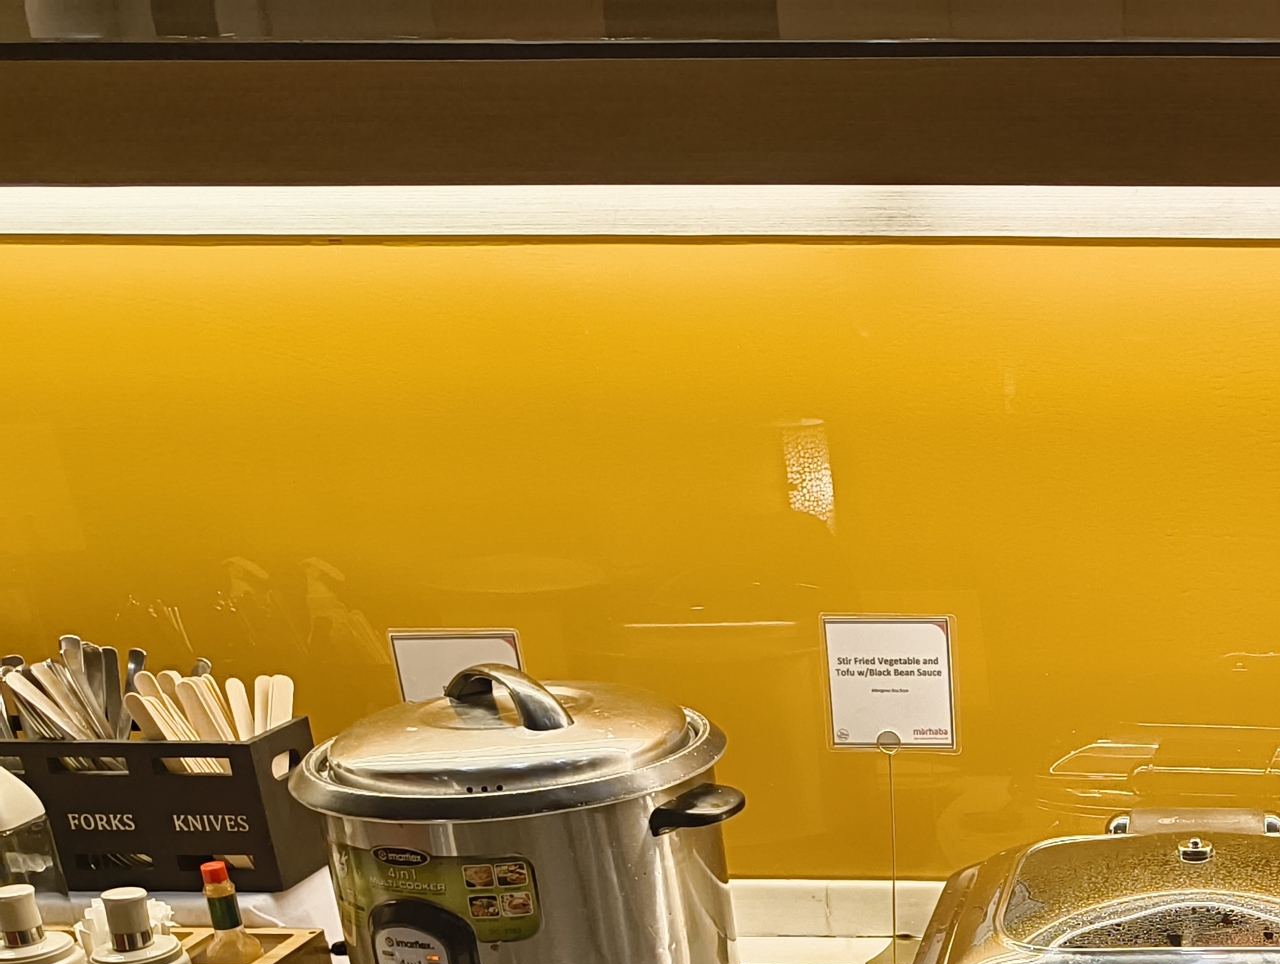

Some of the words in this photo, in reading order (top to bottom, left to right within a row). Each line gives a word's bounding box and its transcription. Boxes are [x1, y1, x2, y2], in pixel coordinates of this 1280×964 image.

[837, 657, 852, 665] Stir
[854, 657, 876, 665] Fried
[877, 657, 920, 667] Vegetable
[922, 657, 939, 665] and
[835, 668, 855, 676] Tofu
[857, 668, 891, 678] w/Black
[894, 668, 915, 676] Bean
[917, 668, 942, 677] Sauce
[67, 813, 136, 831] FORKS
[173, 814, 250, 832] KNIVES
